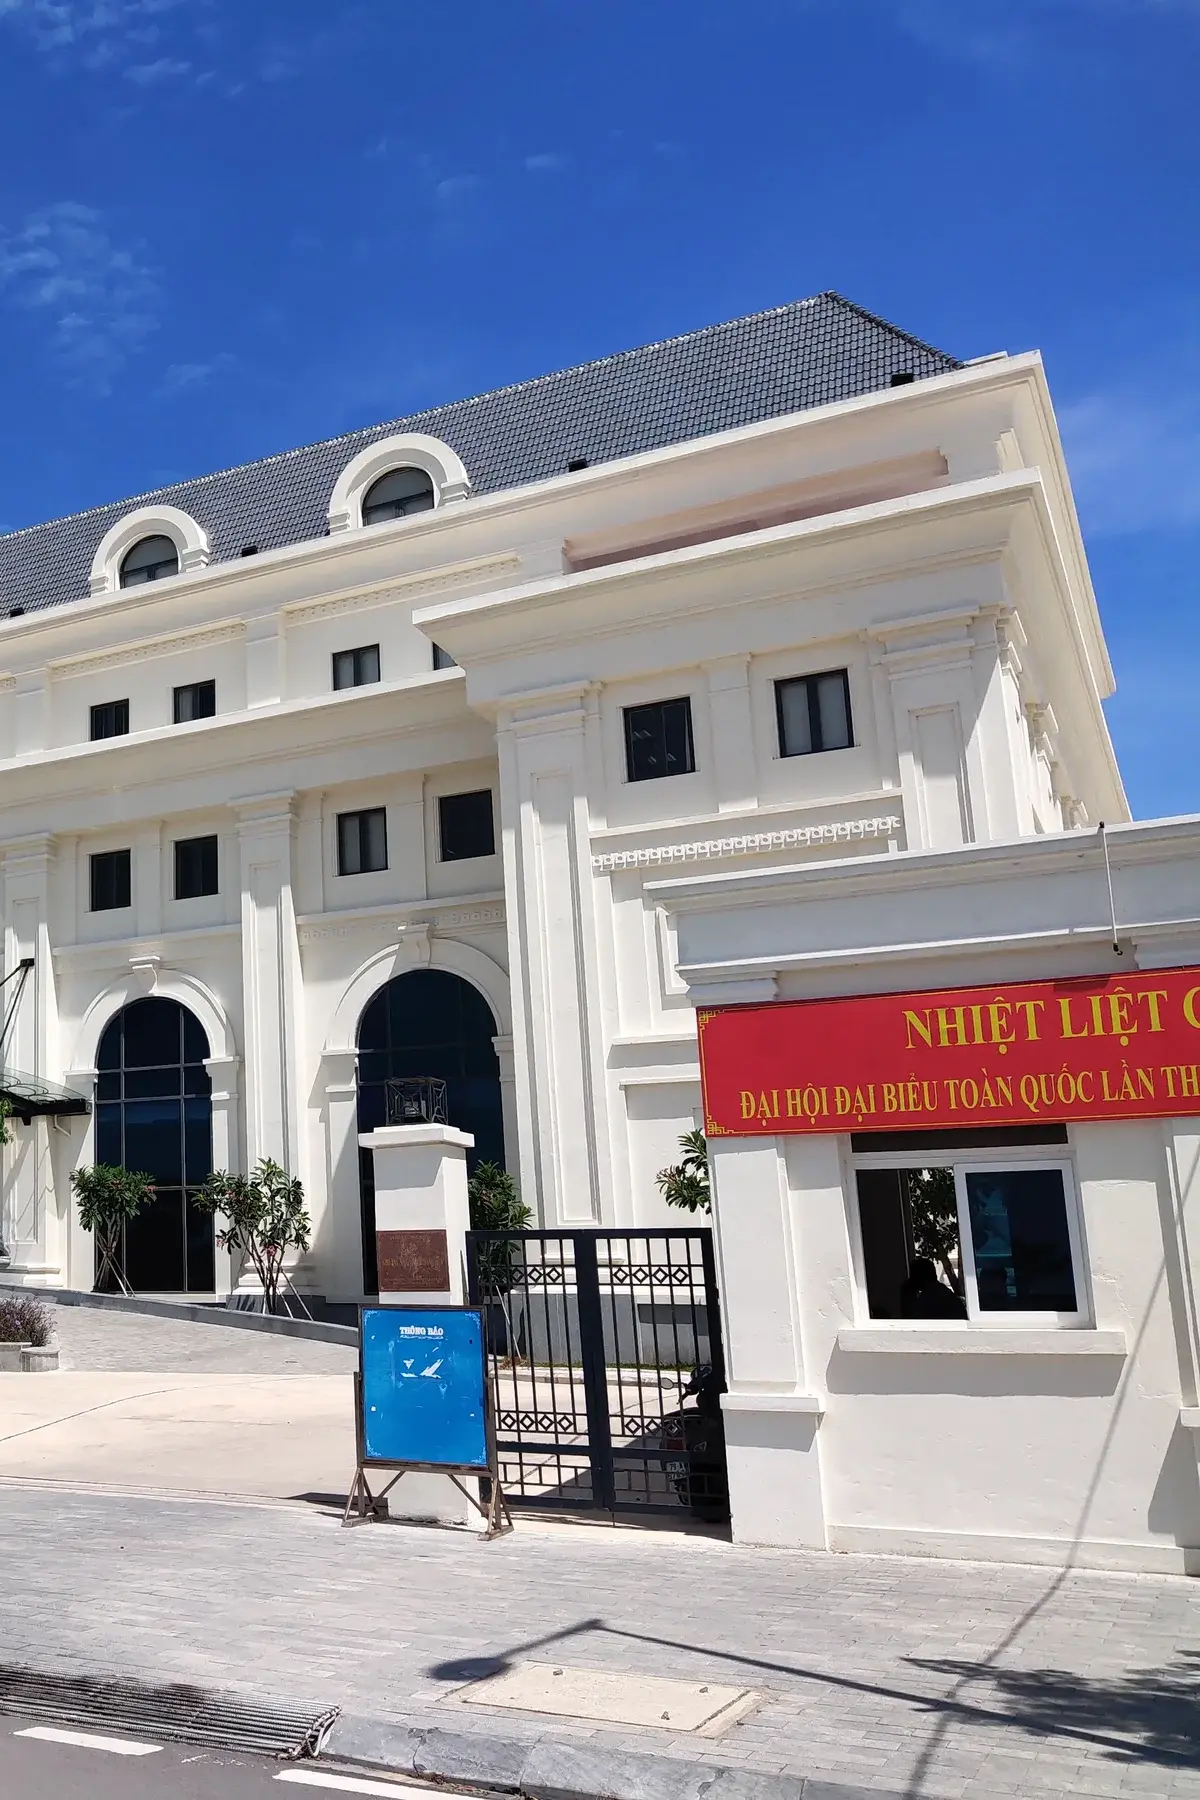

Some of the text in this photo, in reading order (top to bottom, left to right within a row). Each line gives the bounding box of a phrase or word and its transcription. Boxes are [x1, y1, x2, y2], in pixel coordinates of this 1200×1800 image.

[902, 996, 1045, 1055] NHIỆT
[1056, 986, 1168, 1047] LIỆT
[739, 1089, 780, 1127] ĐẠI
[786, 1082, 830, 1125] HỘI
[834, 1084, 877, 1123] ĐẠI
[882, 1072, 938, 1113] BIỂU
[944, 1068, 1014, 1110] TOÀN
[1020, 1062, 1095, 1113] QUỐC
[1100, 1059, 1155, 1102] LẦN
[399, 1325, 426, 1335] THÔNG
